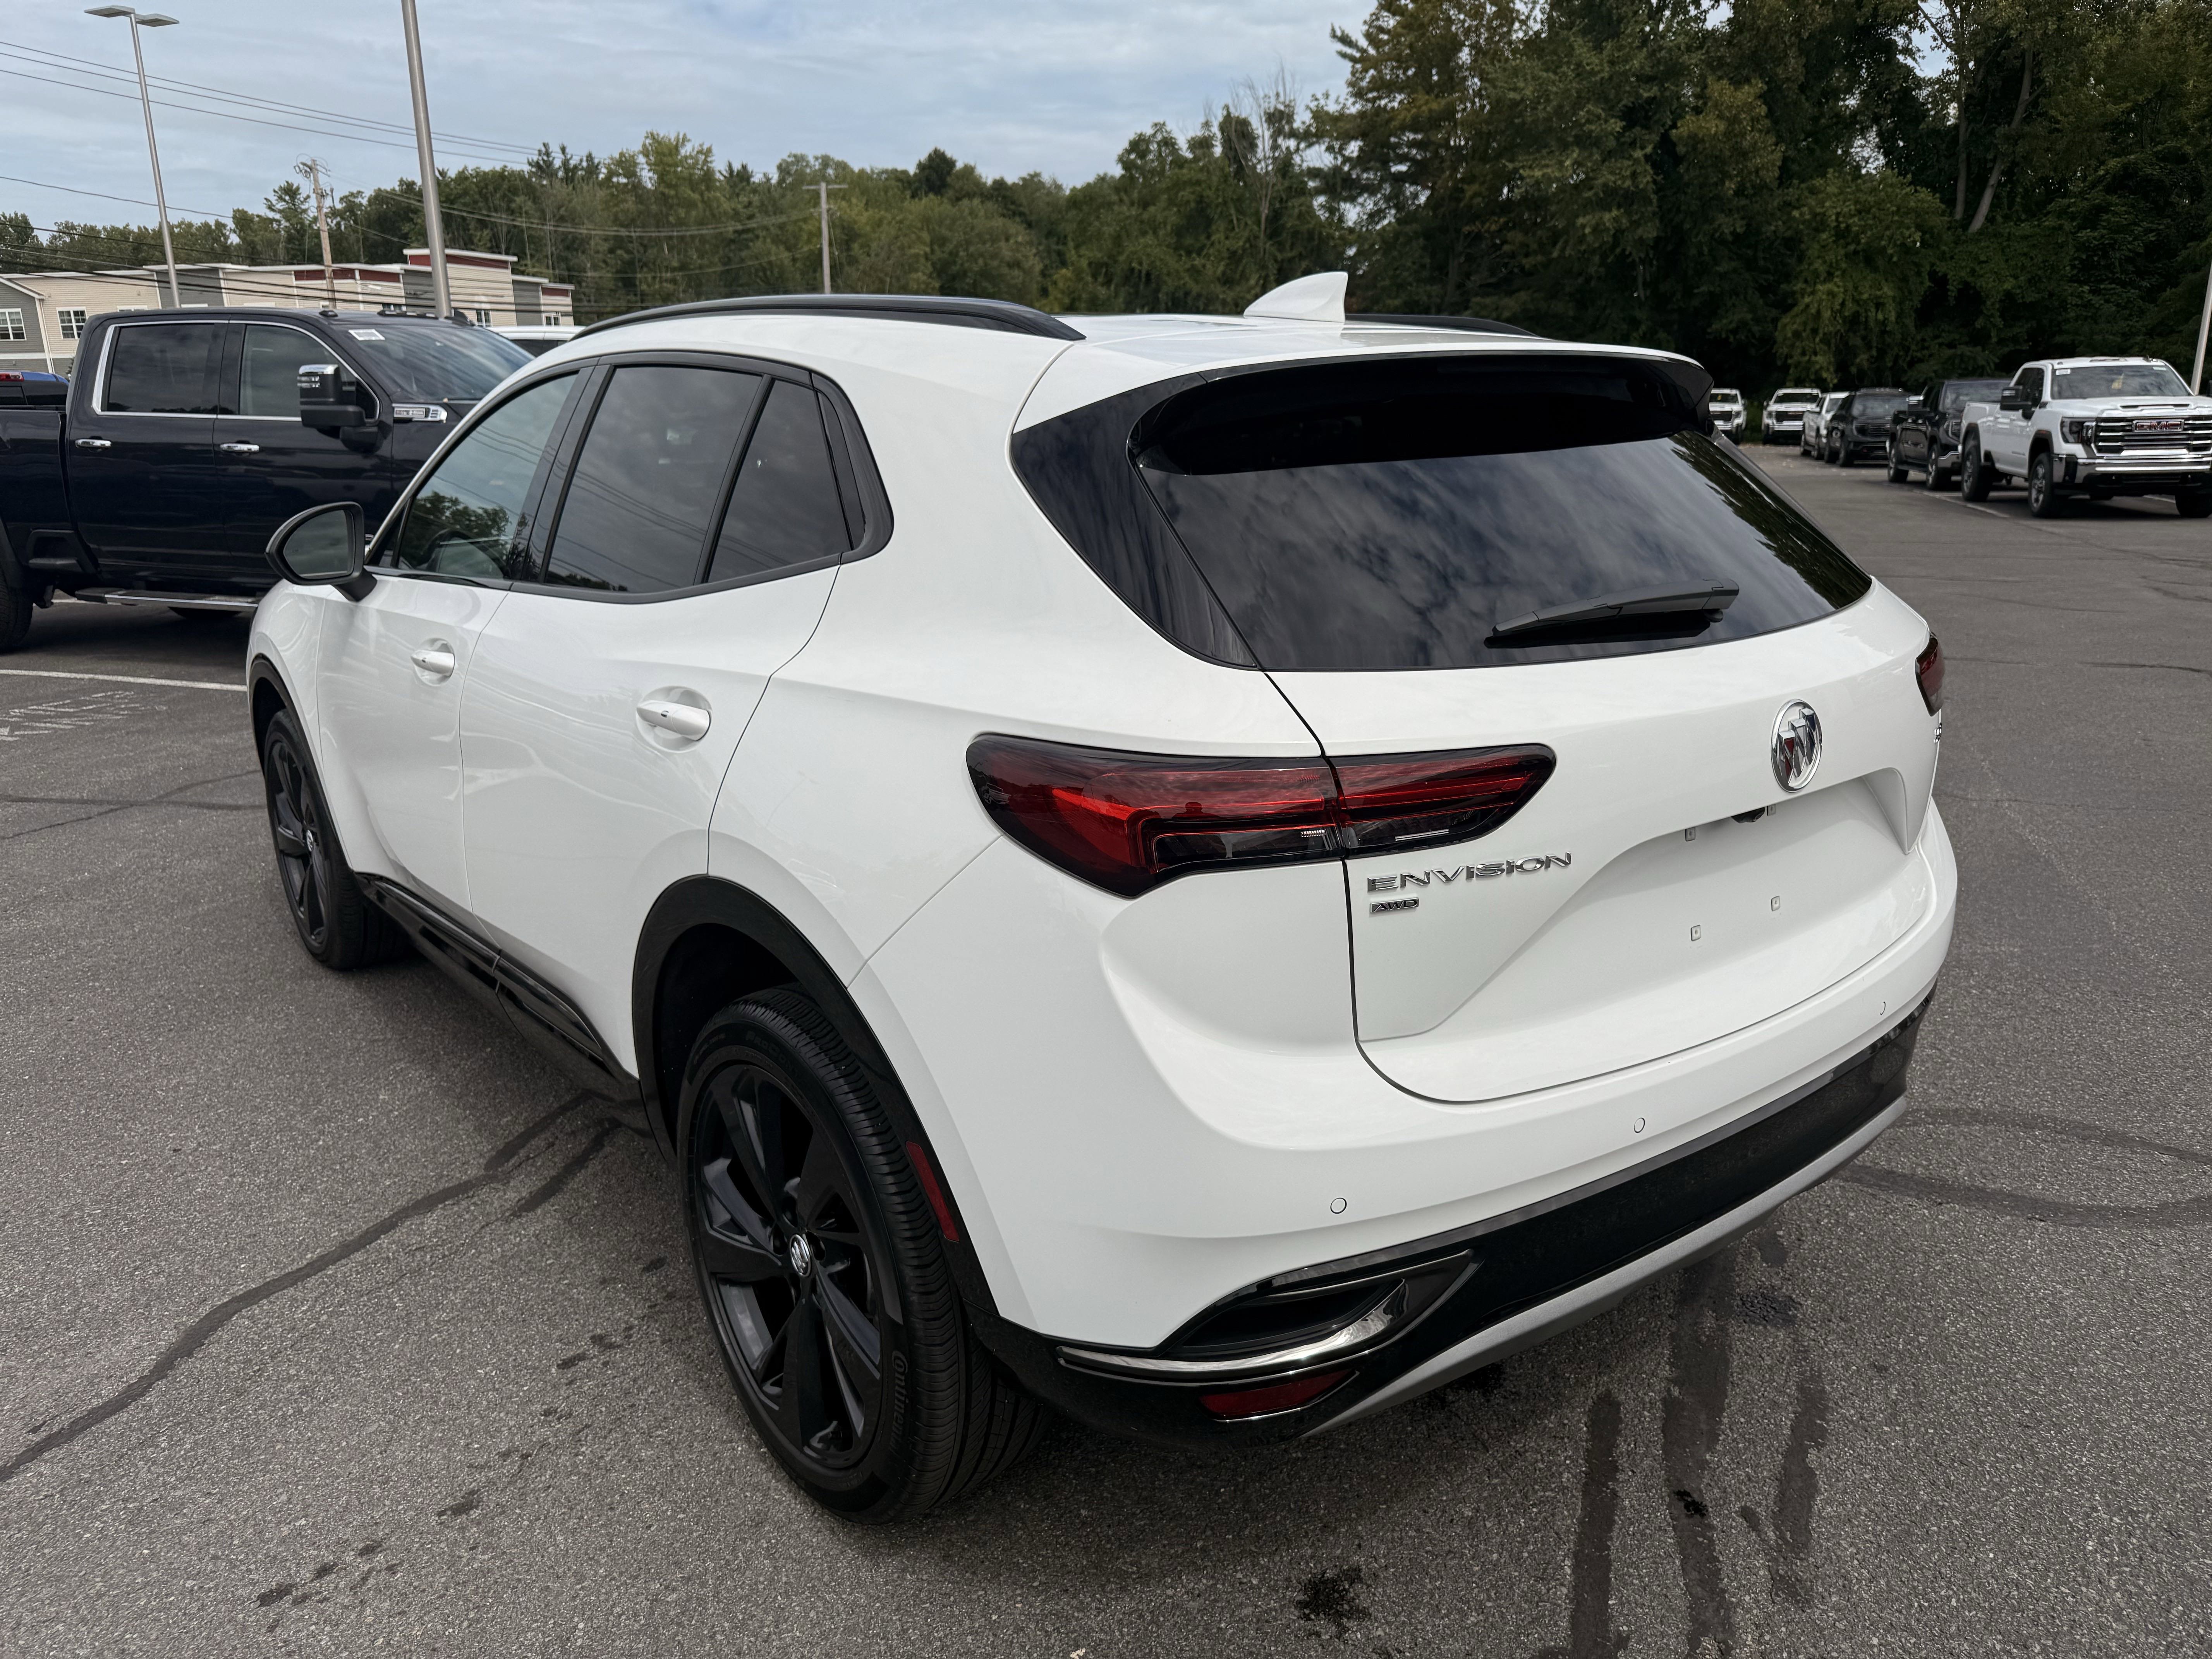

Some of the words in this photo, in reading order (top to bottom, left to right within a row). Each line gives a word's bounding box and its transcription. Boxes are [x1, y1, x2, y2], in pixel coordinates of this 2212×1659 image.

[2136, 421, 2181, 431] GMC
[1367, 852, 1572, 892] ENVISION
[1373, 900, 1417, 912] AWD
